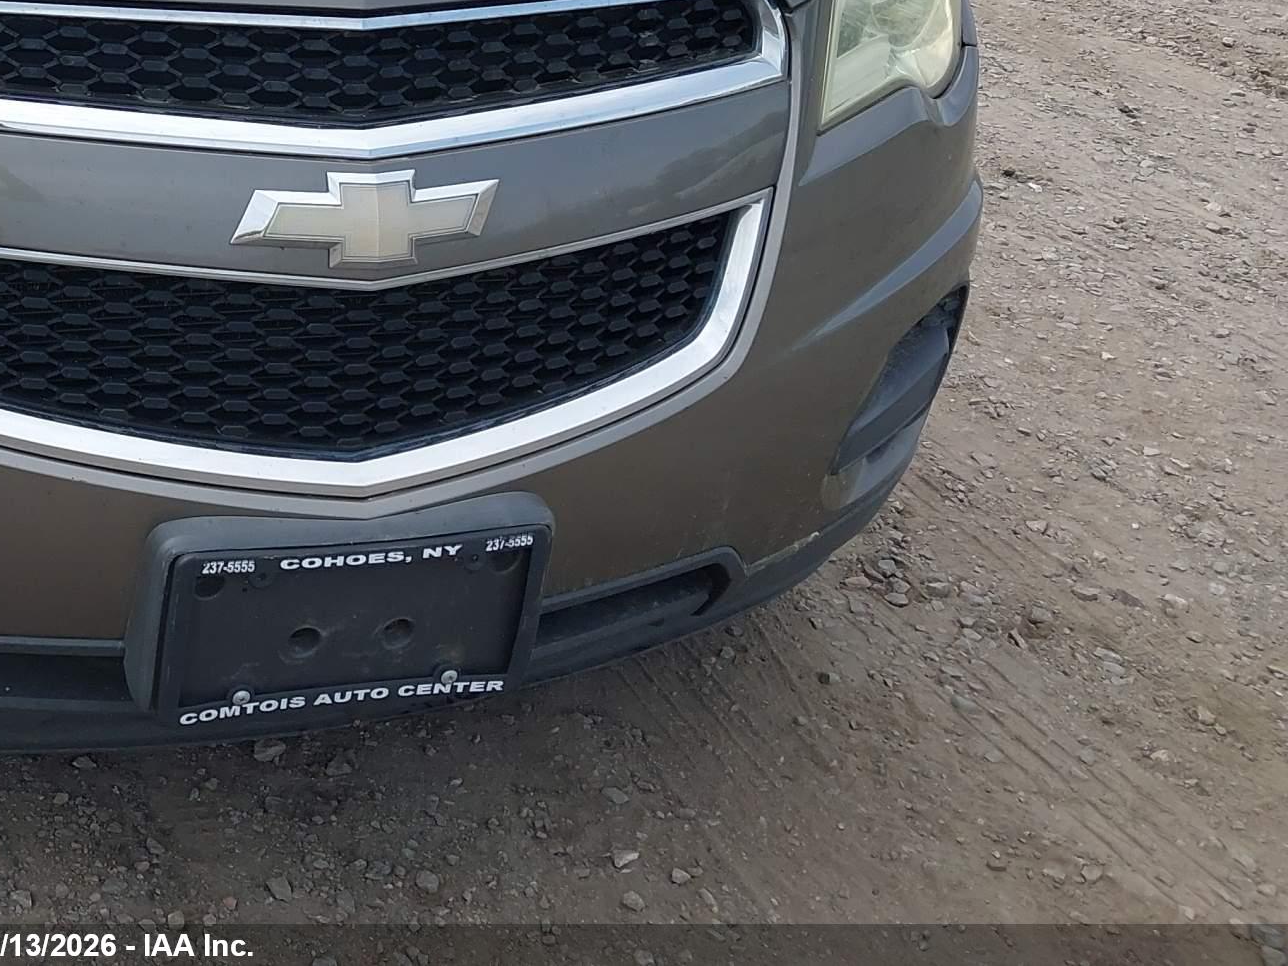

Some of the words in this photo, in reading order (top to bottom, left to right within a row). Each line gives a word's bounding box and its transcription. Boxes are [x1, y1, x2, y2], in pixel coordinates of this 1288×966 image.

[485, 534, 534, 552] 237-5555
[201, 559, 256, 575] 237-5555
[279, 550, 413, 572] COHOES,
[422, 544, 463, 559] NY
[179, 696, 306, 726] COMTOIS
[313, 687, 389, 706] AUTO
[397, 679, 505, 697] CENTER
